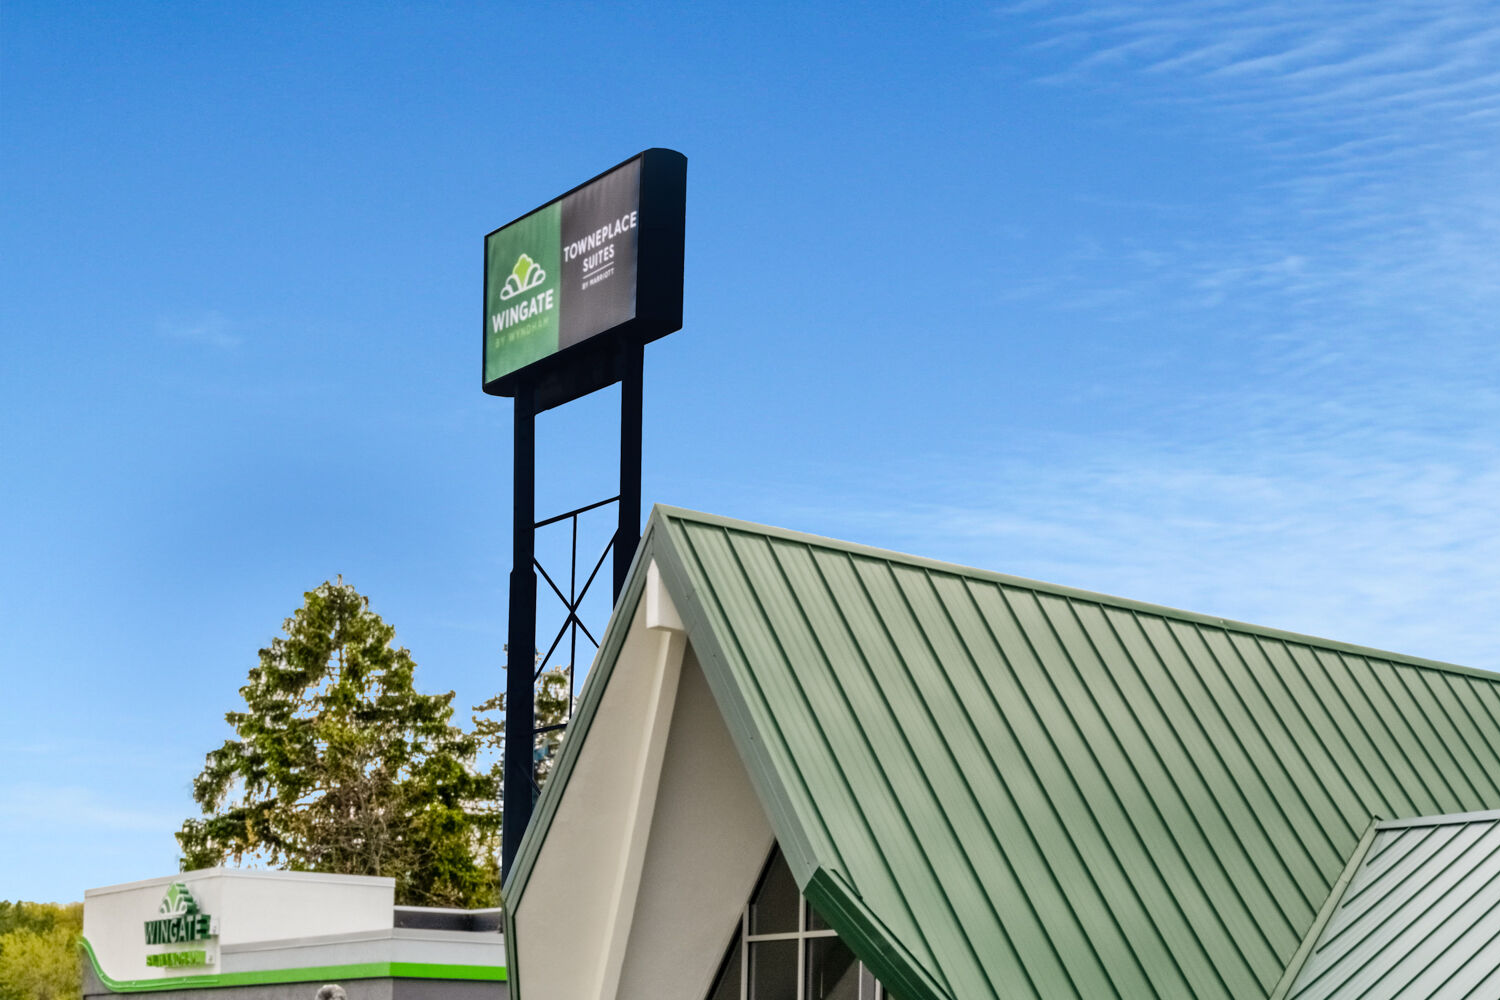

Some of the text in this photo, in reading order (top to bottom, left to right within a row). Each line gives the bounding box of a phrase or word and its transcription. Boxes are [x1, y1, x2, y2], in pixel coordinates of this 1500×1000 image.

[563, 210, 637, 262] TOWNEPLACE
[582, 243, 615, 273] SUITES
[589, 267, 615, 286] MARRIOTT
[492, 288, 554, 334] WINGATE
[143, 913, 206, 945] WINGATE
